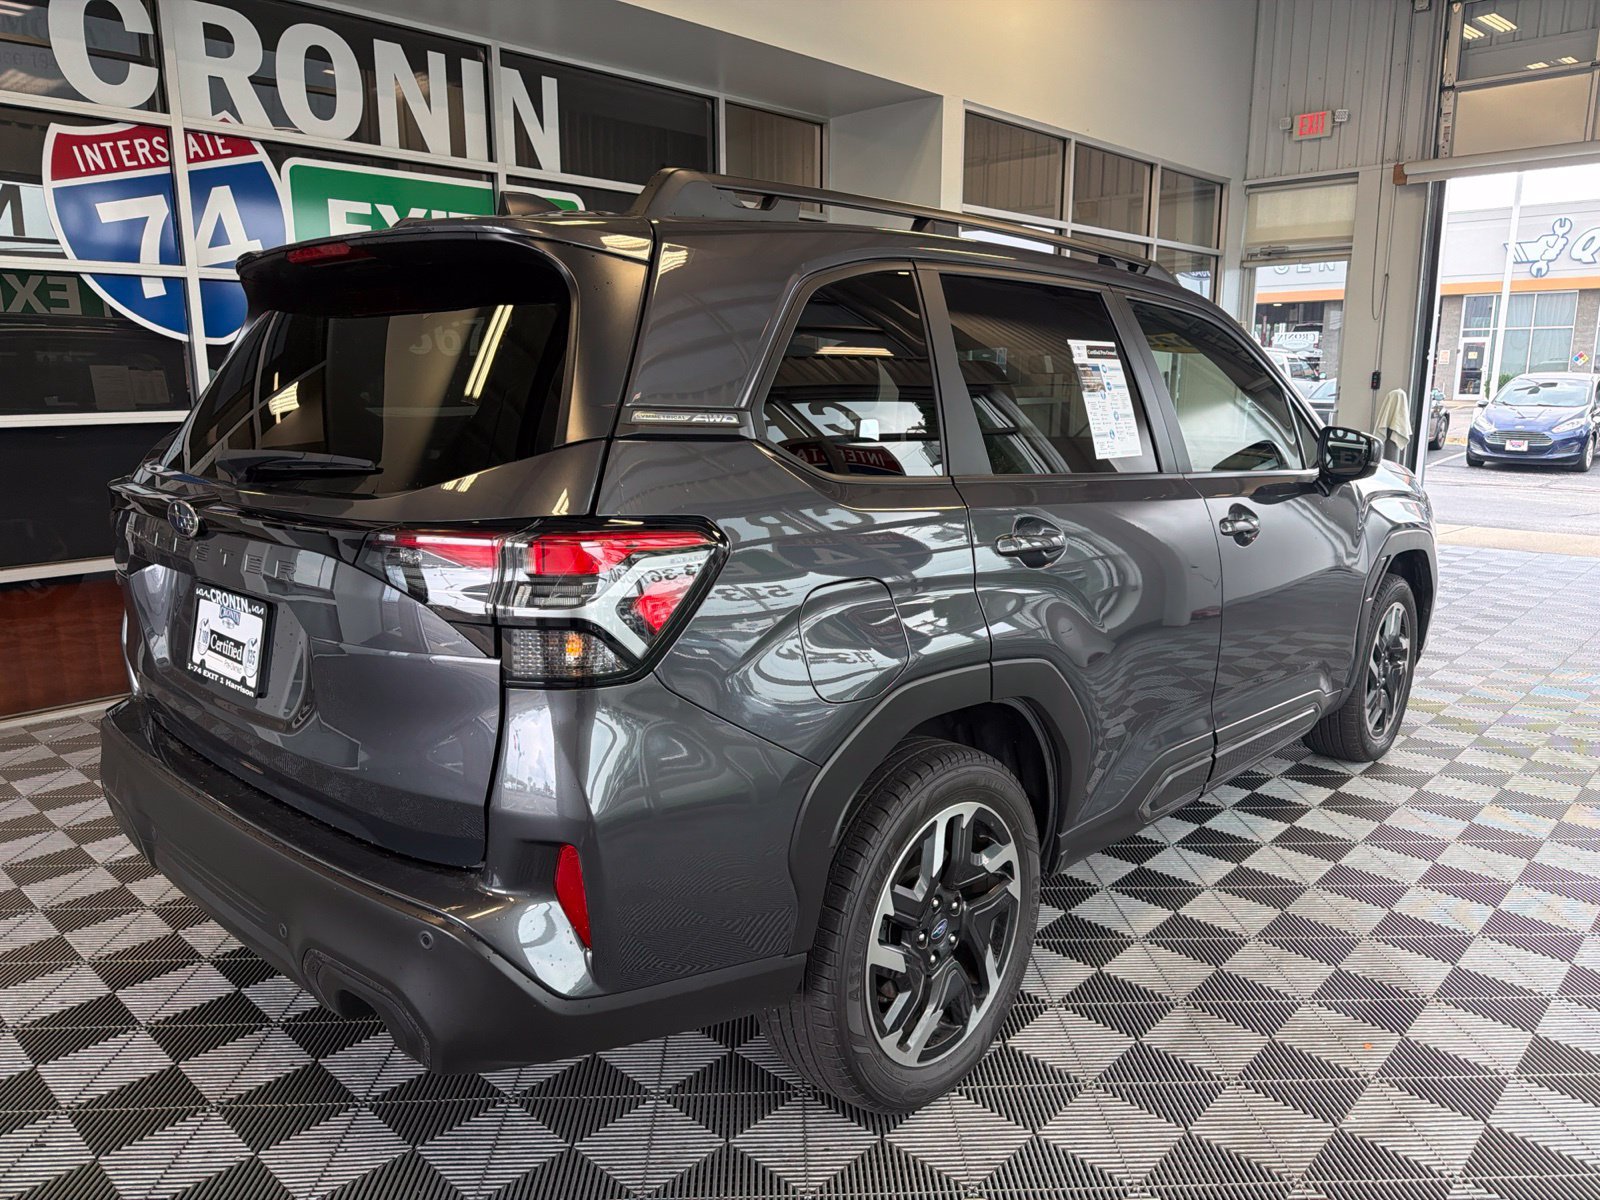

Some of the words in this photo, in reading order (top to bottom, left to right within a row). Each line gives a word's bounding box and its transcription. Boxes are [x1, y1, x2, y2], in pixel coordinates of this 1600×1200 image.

[48, 0, 562, 174] CRONIN
[1298, 112, 1327, 136] EXIT
[72, 133, 232, 173] INTERSATE
[95, 185, 263, 299] 74
[691, 414, 739, 424] AWD
[210, 588, 249, 613] CRONIN
[211, 633, 243, 661] Certified
[187, 662, 202, 674] I-74
[203, 670, 219, 681] EXIT
[225, 679, 255, 698] Harrison
